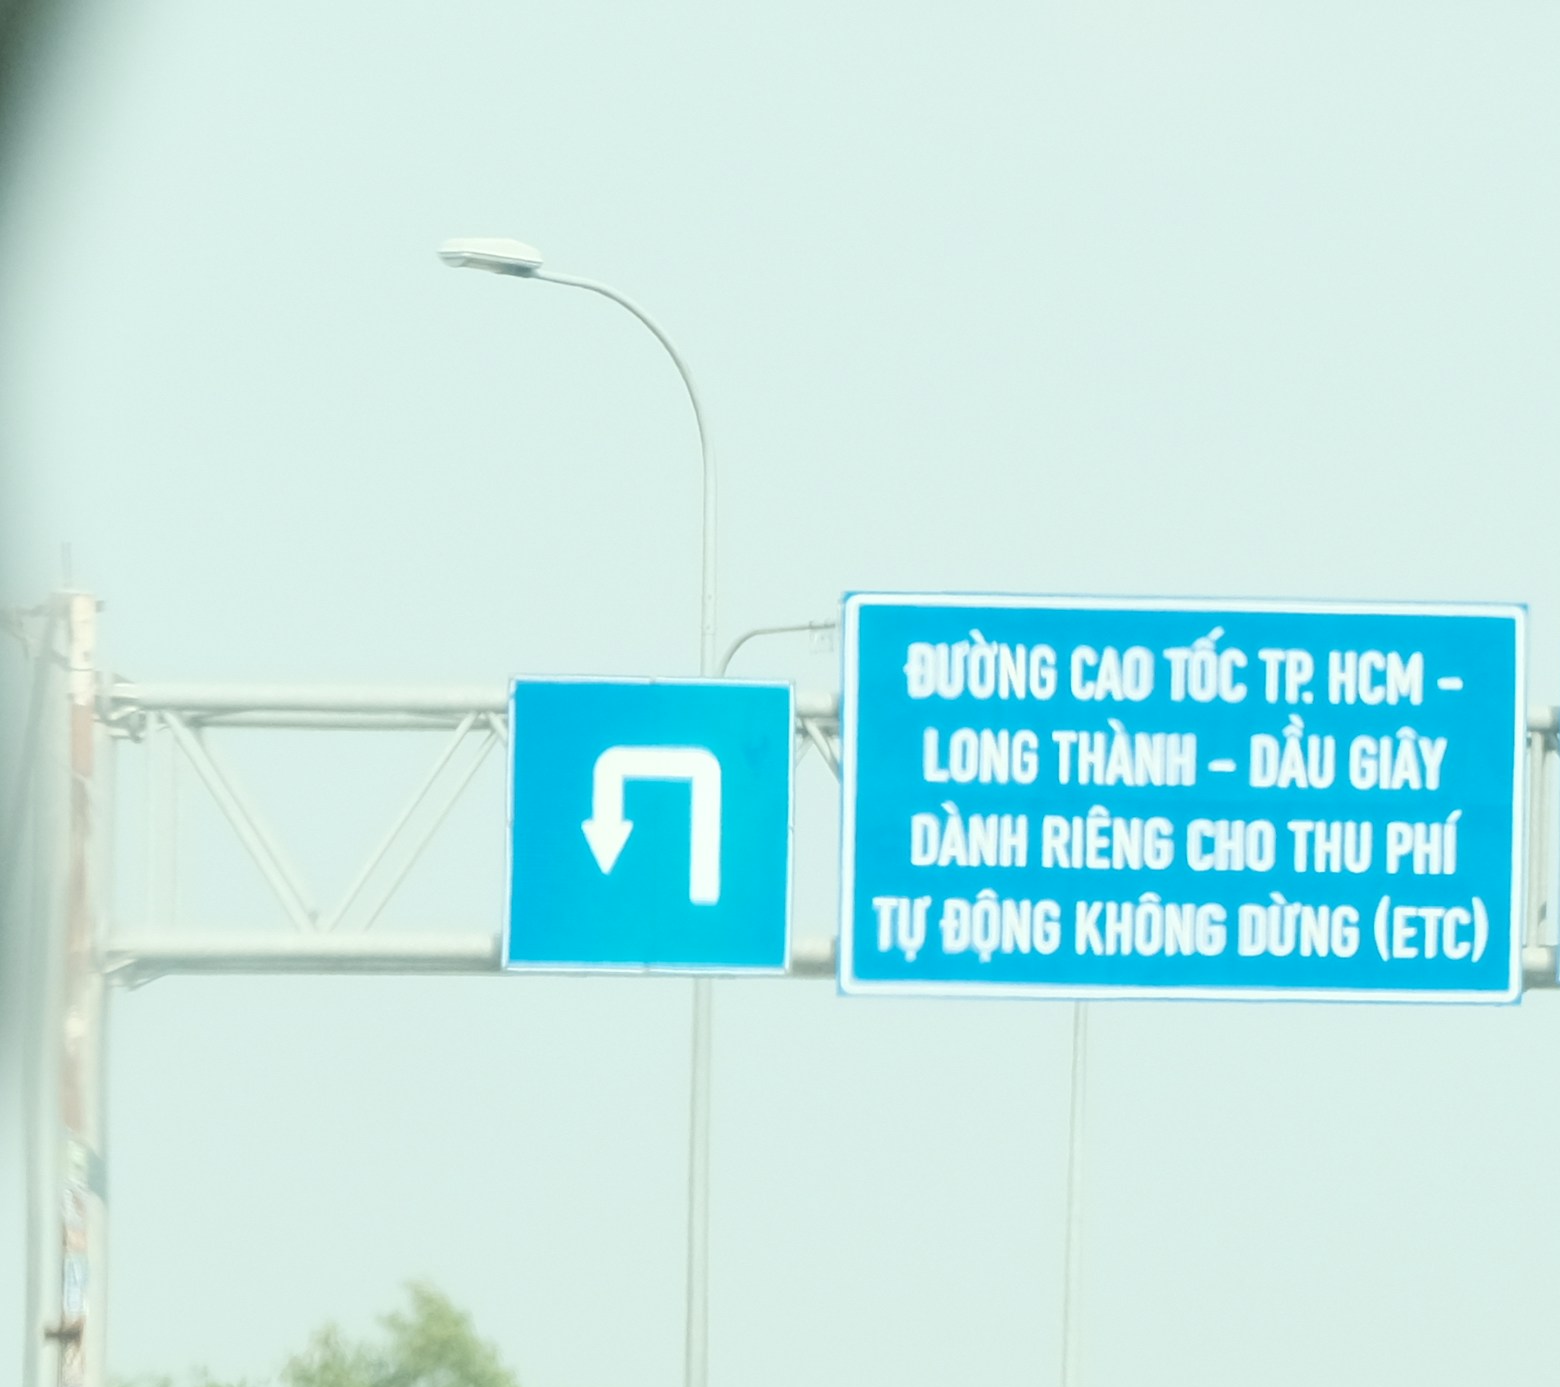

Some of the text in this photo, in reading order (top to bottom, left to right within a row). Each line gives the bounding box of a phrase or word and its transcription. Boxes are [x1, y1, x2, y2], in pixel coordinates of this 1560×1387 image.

[903, 628, 1058, 701] ĐƯỜNG
[1070, 645, 1155, 702] CAO
[1163, 626, 1248, 703] TỐC
[1258, 648, 1315, 704] TP.
[1328, 650, 1424, 706] HCM
[923, 727, 1039, 785] LONG
[1051, 718, 1197, 787] THÀNH
[1249, 713, 1336, 790] DẦU
[1349, 726, 1448, 791] GIÂY
[910, 800, 1462, 875] DÀNH RIÊNG CHO THU PHÍ
[872, 888, 1489, 963] TỰ ĐỘNG KHÔNG DỪNG (ETC)
